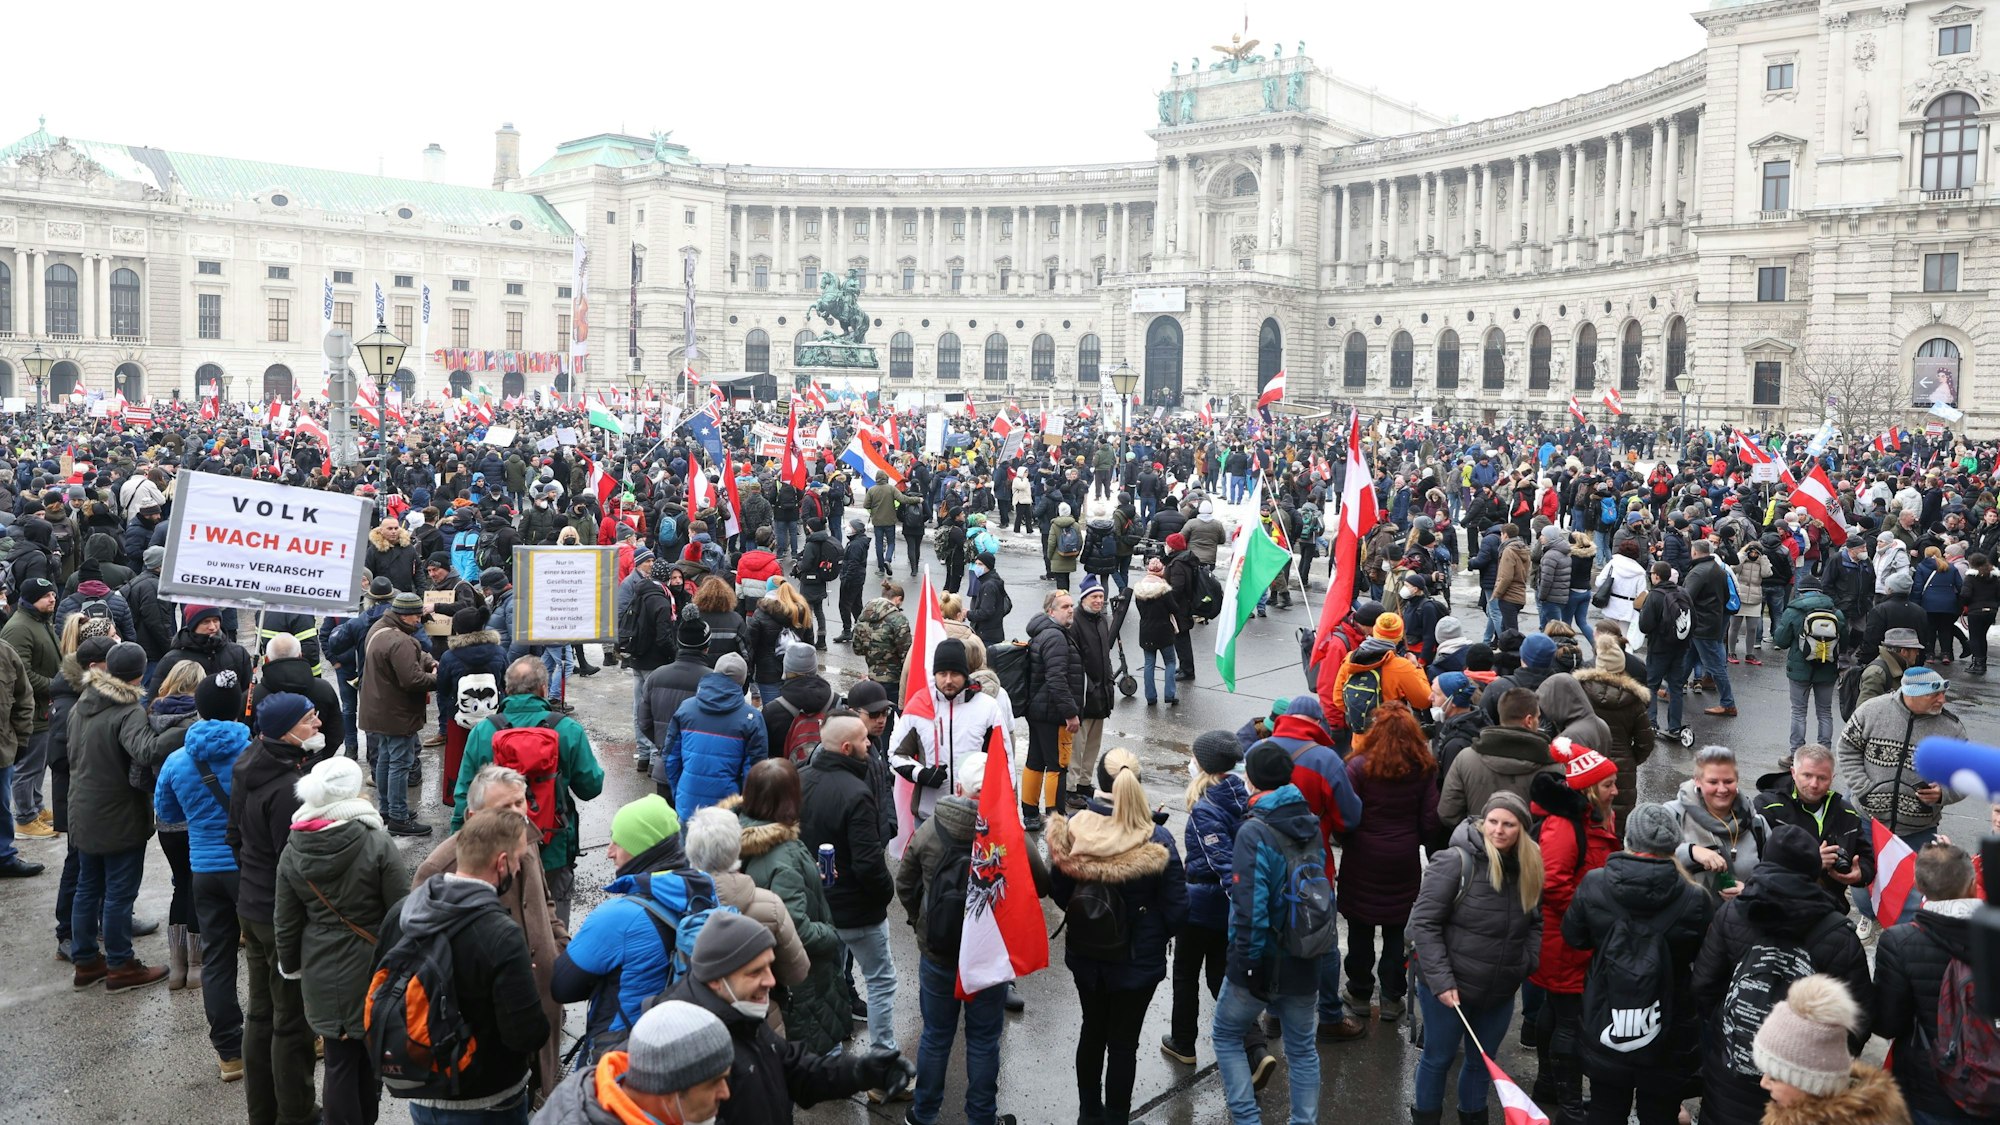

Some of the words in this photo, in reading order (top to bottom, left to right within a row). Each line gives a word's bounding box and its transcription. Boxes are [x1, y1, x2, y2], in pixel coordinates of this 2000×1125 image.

[233, 496, 319, 523] VOLK
[205, 526, 280, 551] WACH
[287, 537, 334, 557] AUF
[220, 562, 245, 570] WIRST
[249, 561, 325, 578] VERARSCHT
[181, 573, 260, 590] GESPALTEN
[284, 584, 341, 598] BELOGEN
[1570, 752, 1603, 774] AUS
[1611, 1000, 1661, 1037] NIKE
